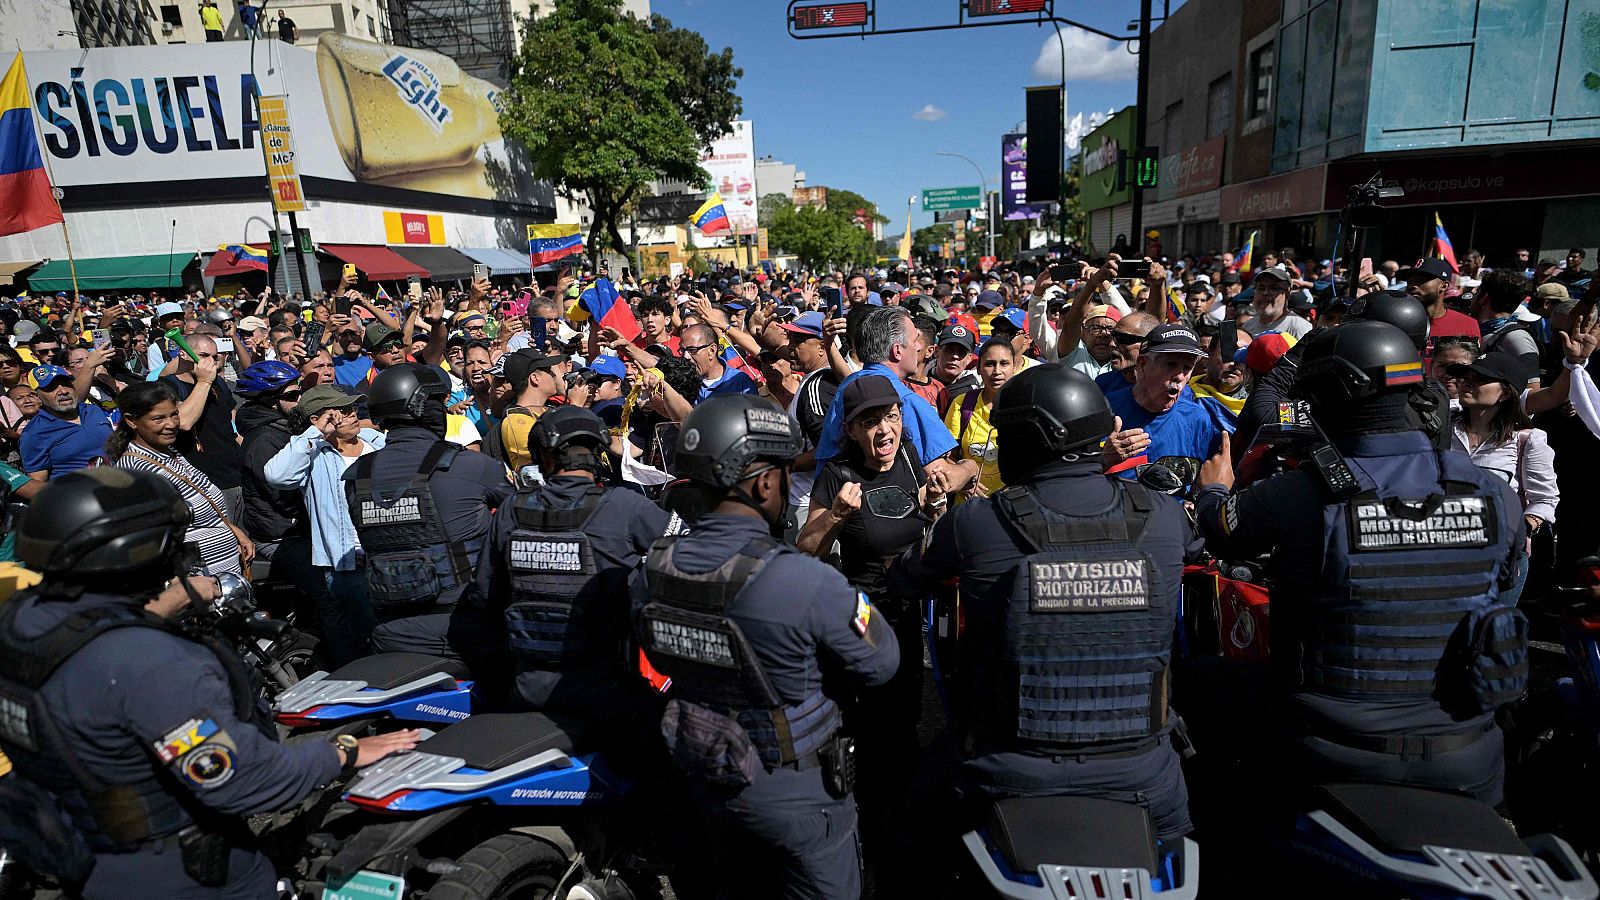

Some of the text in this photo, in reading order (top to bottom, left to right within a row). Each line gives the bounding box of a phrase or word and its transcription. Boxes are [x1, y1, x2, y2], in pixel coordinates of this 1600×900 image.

[410, 60, 439, 89] POLAR
[383, 55, 448, 123] Light
[35, 67, 262, 159] SÍGUELA
[263, 124, 290, 132] ¿Ganas
[269, 137, 282, 147] de
[272, 151, 294, 164] Mc?
[1239, 190, 1291, 214] KAPSULA
[1161, 330, 1198, 342] VENEZUELA
[749, 409, 790, 425] DIVISION
[362, 505, 419, 519] MOTORIZADA
[1227, 494, 1238, 532] CPNB
[1360, 515, 1483, 533] MOTORIZADA
[511, 540, 580, 553] DIVISION
[1360, 533, 1400, 547] UNIDAD
[1402, 532, 1415, 544] DE
[1416, 531, 1429, 543] LA
[511, 551, 580, 563] MOTORIZADA
[1036, 560, 1142, 580] DIVISION
[1037, 579, 1145, 597] MOTORIZADA
[1038, 596, 1145, 608] UNIDAD DE LA PRECISION
[415, 703, 448, 717] DIVISIÓN
[511, 788, 553, 799] DIVISIÓN
